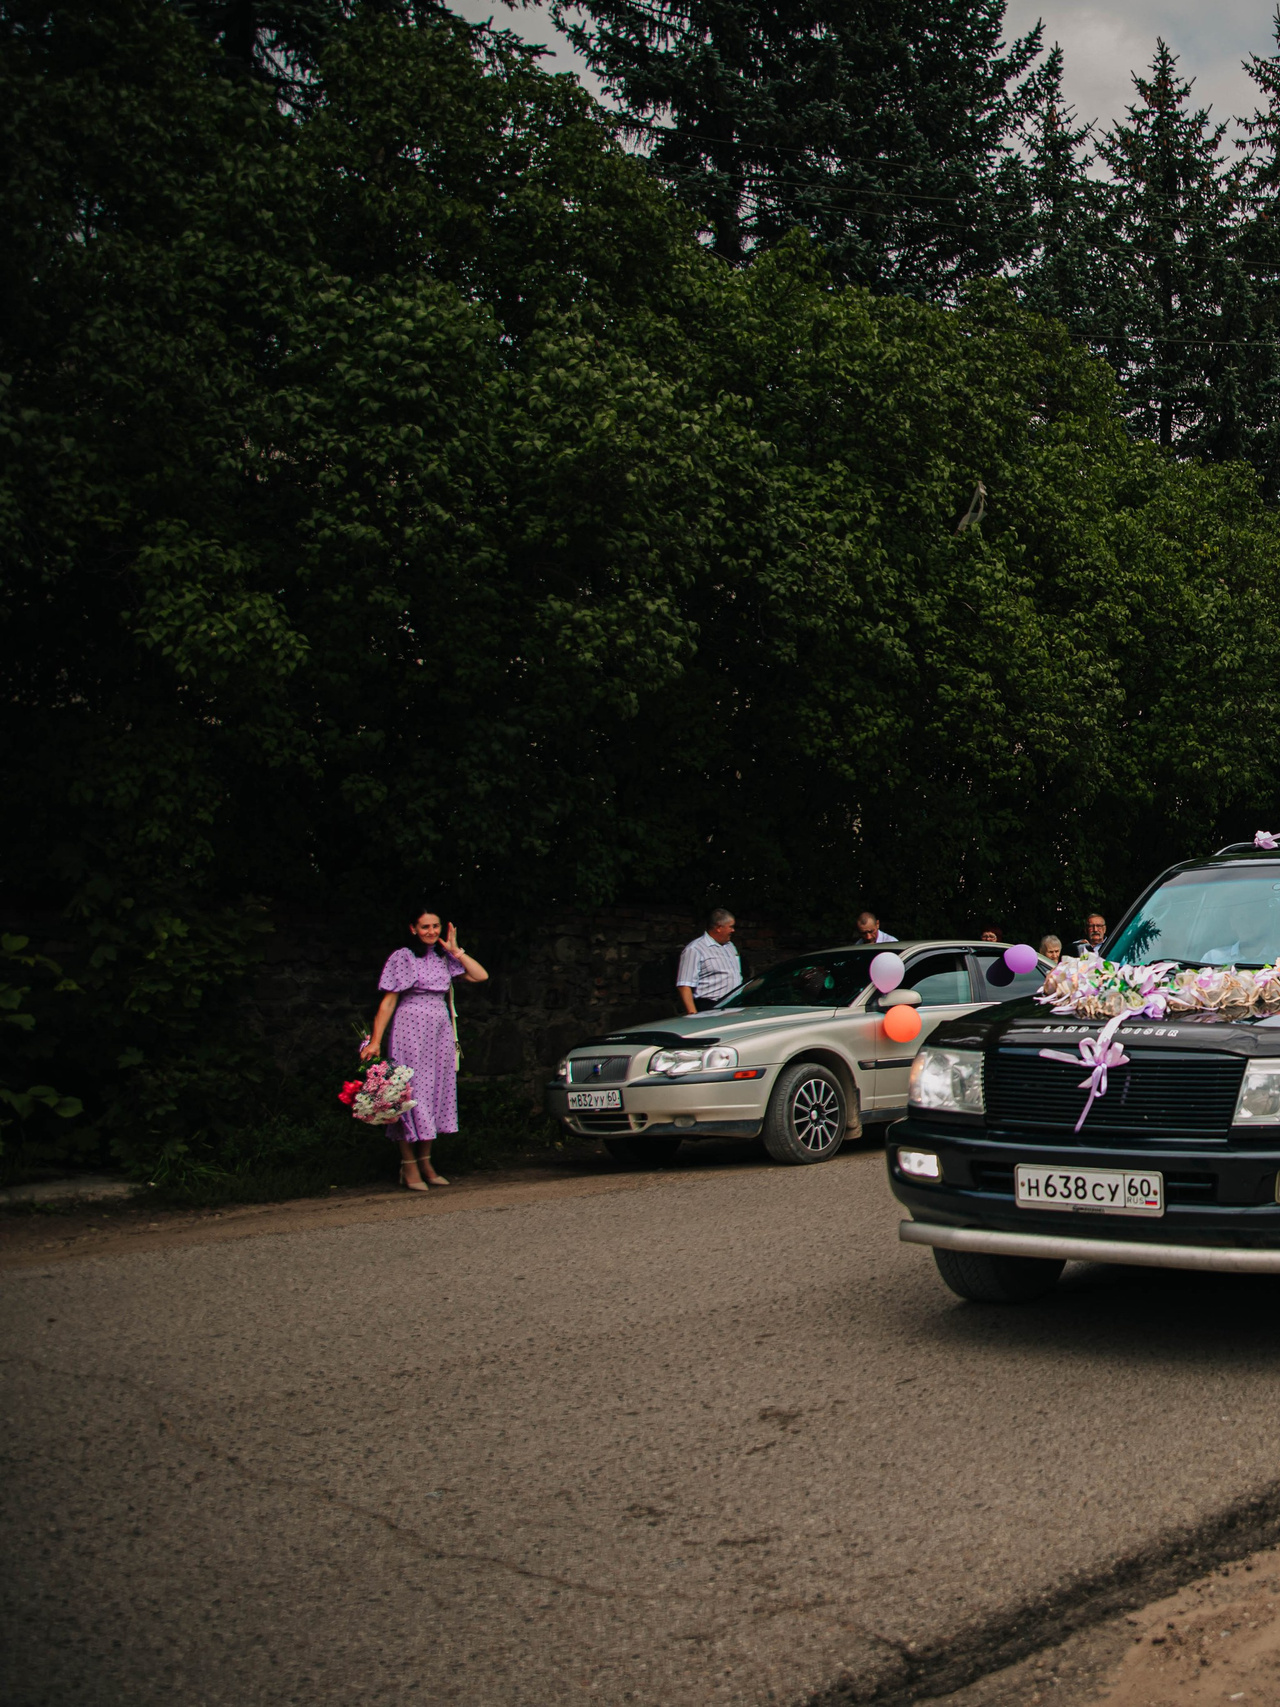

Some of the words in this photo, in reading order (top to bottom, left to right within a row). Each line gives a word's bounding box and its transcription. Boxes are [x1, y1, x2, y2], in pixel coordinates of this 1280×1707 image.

[1042, 1025, 1089, 1033] LAND
[607, 1091, 617, 1102] 60
[1127, 1178, 1151, 1197] 60
[1126, 1196, 1144, 1205] RUS
